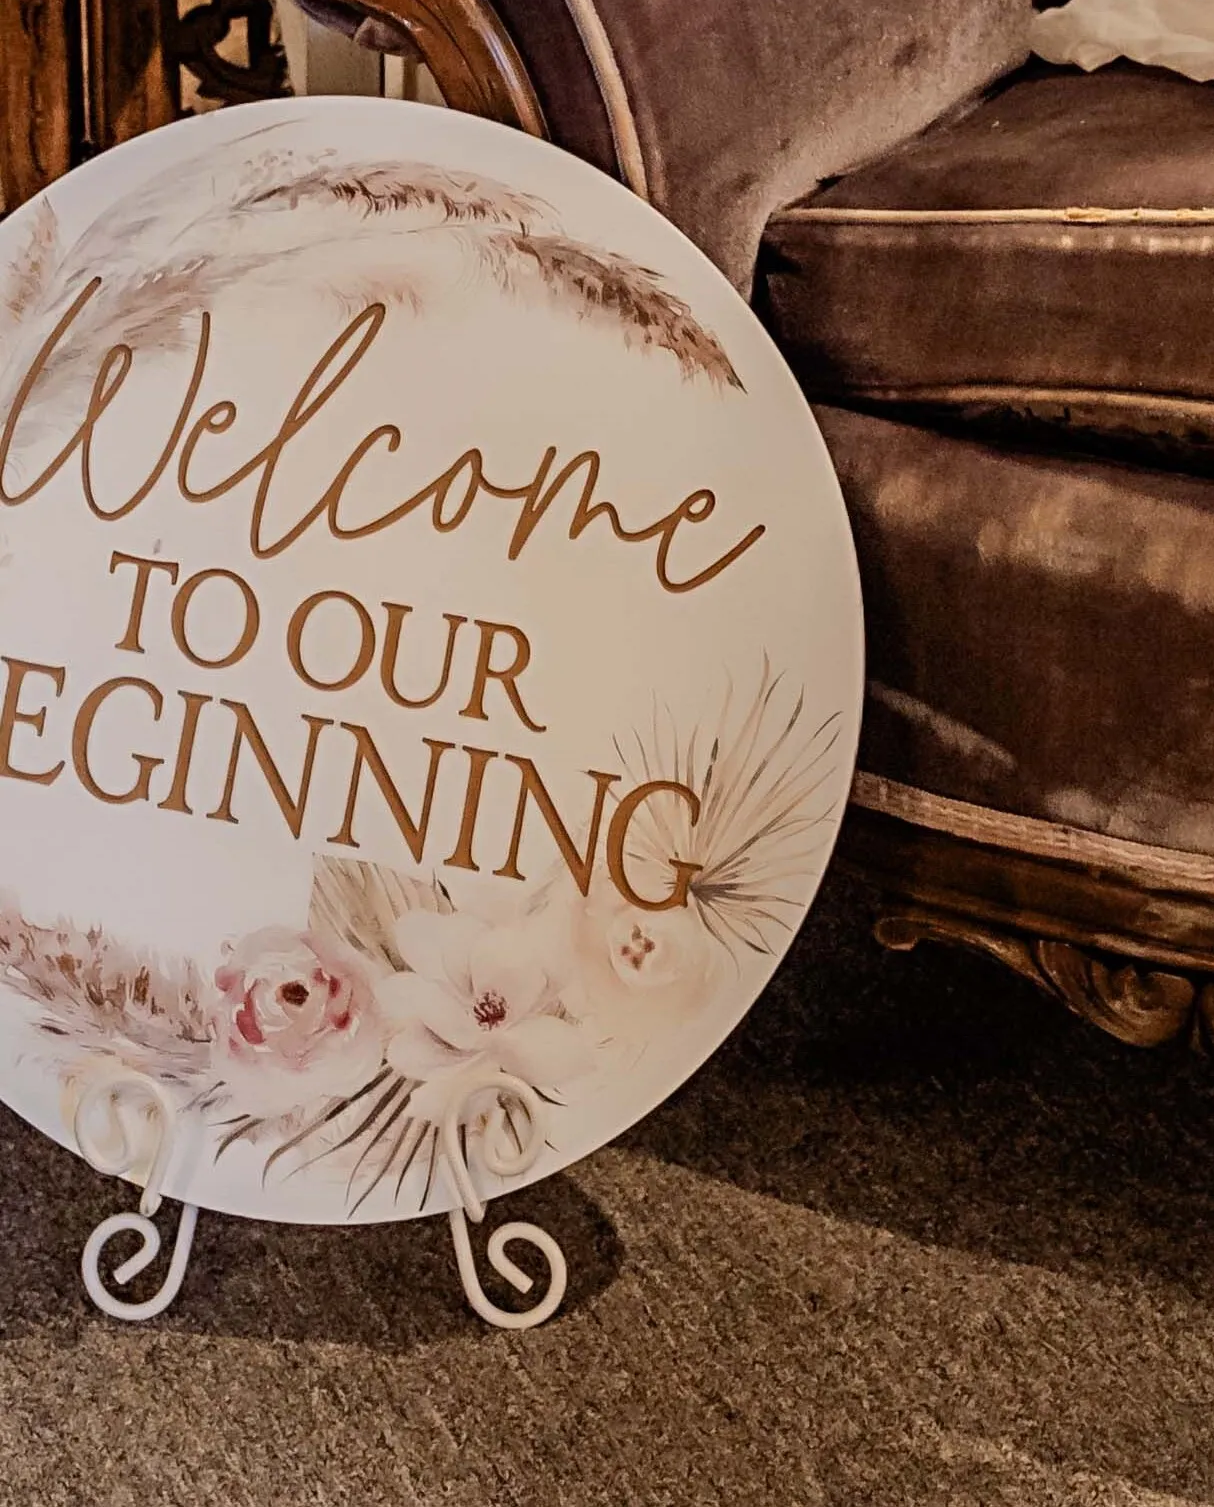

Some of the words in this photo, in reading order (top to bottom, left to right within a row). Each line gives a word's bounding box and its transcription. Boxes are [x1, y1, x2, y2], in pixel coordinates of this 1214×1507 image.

[0, 276, 765, 593] Welcome
[110, 550, 260, 668] TO
[286, 590, 546, 733] OUR
